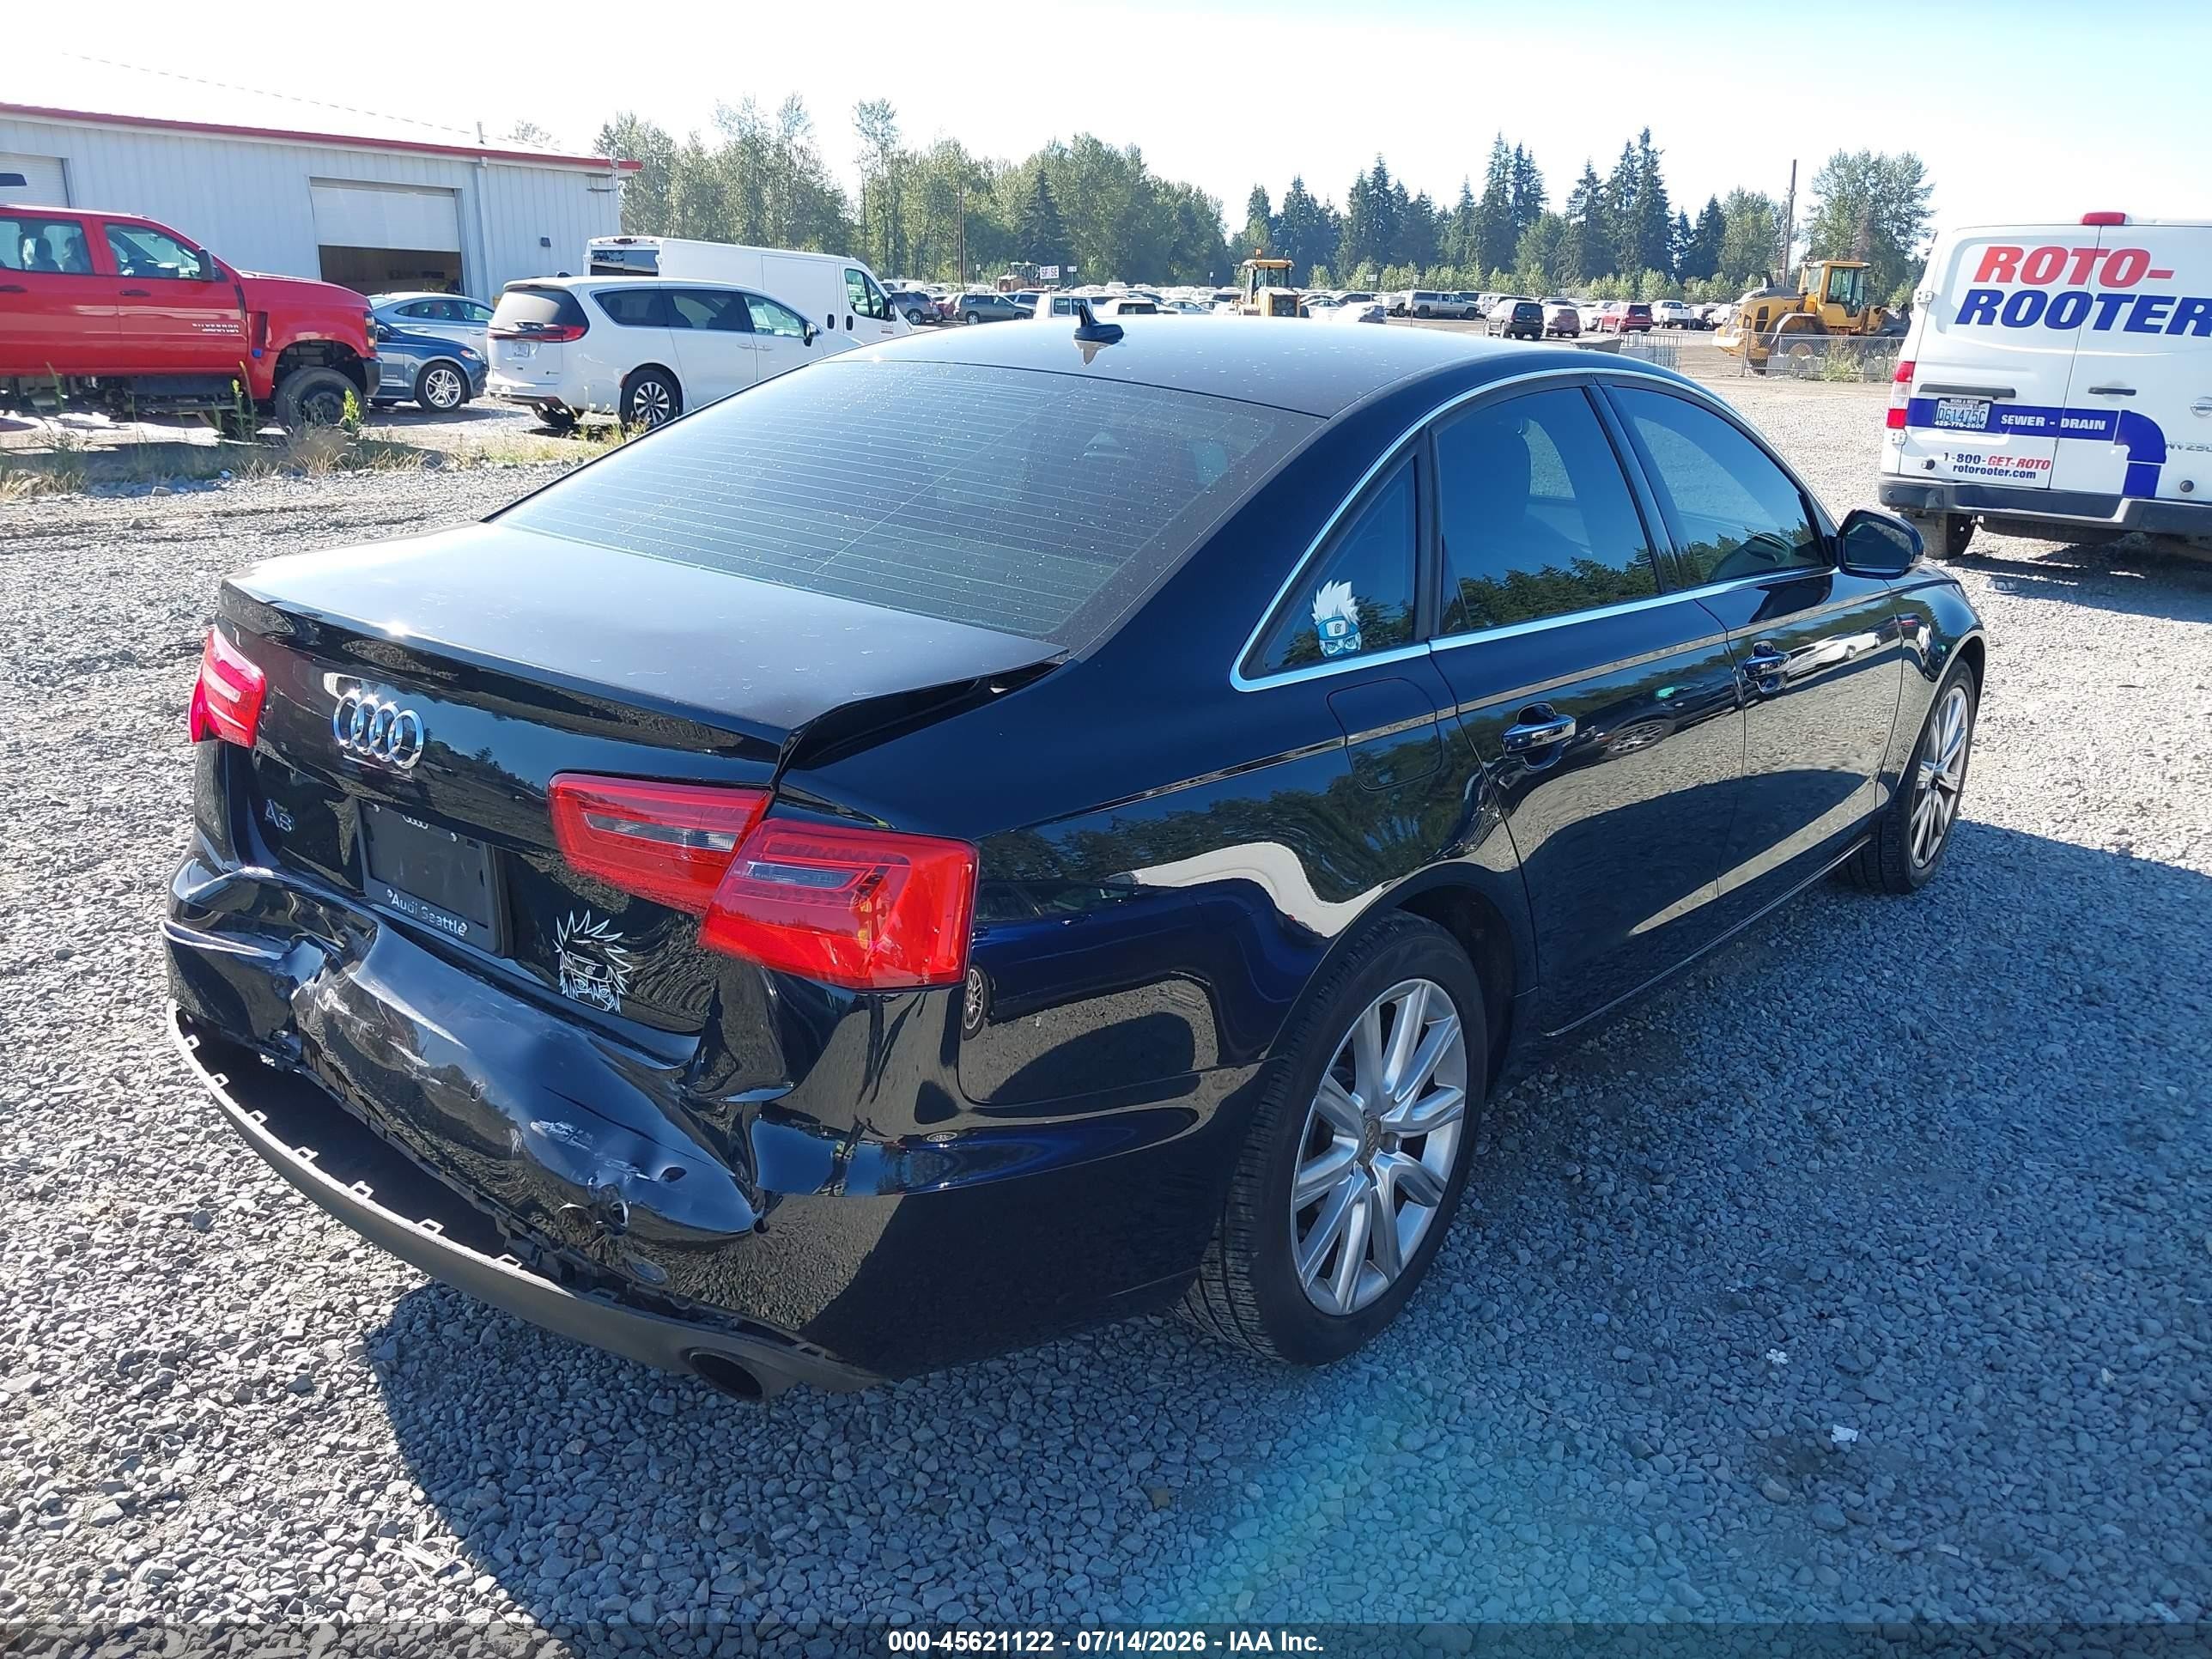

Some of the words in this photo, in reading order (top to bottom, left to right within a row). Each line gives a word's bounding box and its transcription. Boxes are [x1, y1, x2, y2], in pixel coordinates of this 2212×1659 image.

[1973, 246, 2174, 289] ROTO-
[1954, 289, 2212, 337] ROOTER
[2000, 414, 2045, 427] SEWER
[2060, 417, 2106, 431] DRAIN
[1953, 464, 2036, 479] rotorooter.com
[391, 893, 419, 915] Audi
[421, 906, 467, 937] Seattle
